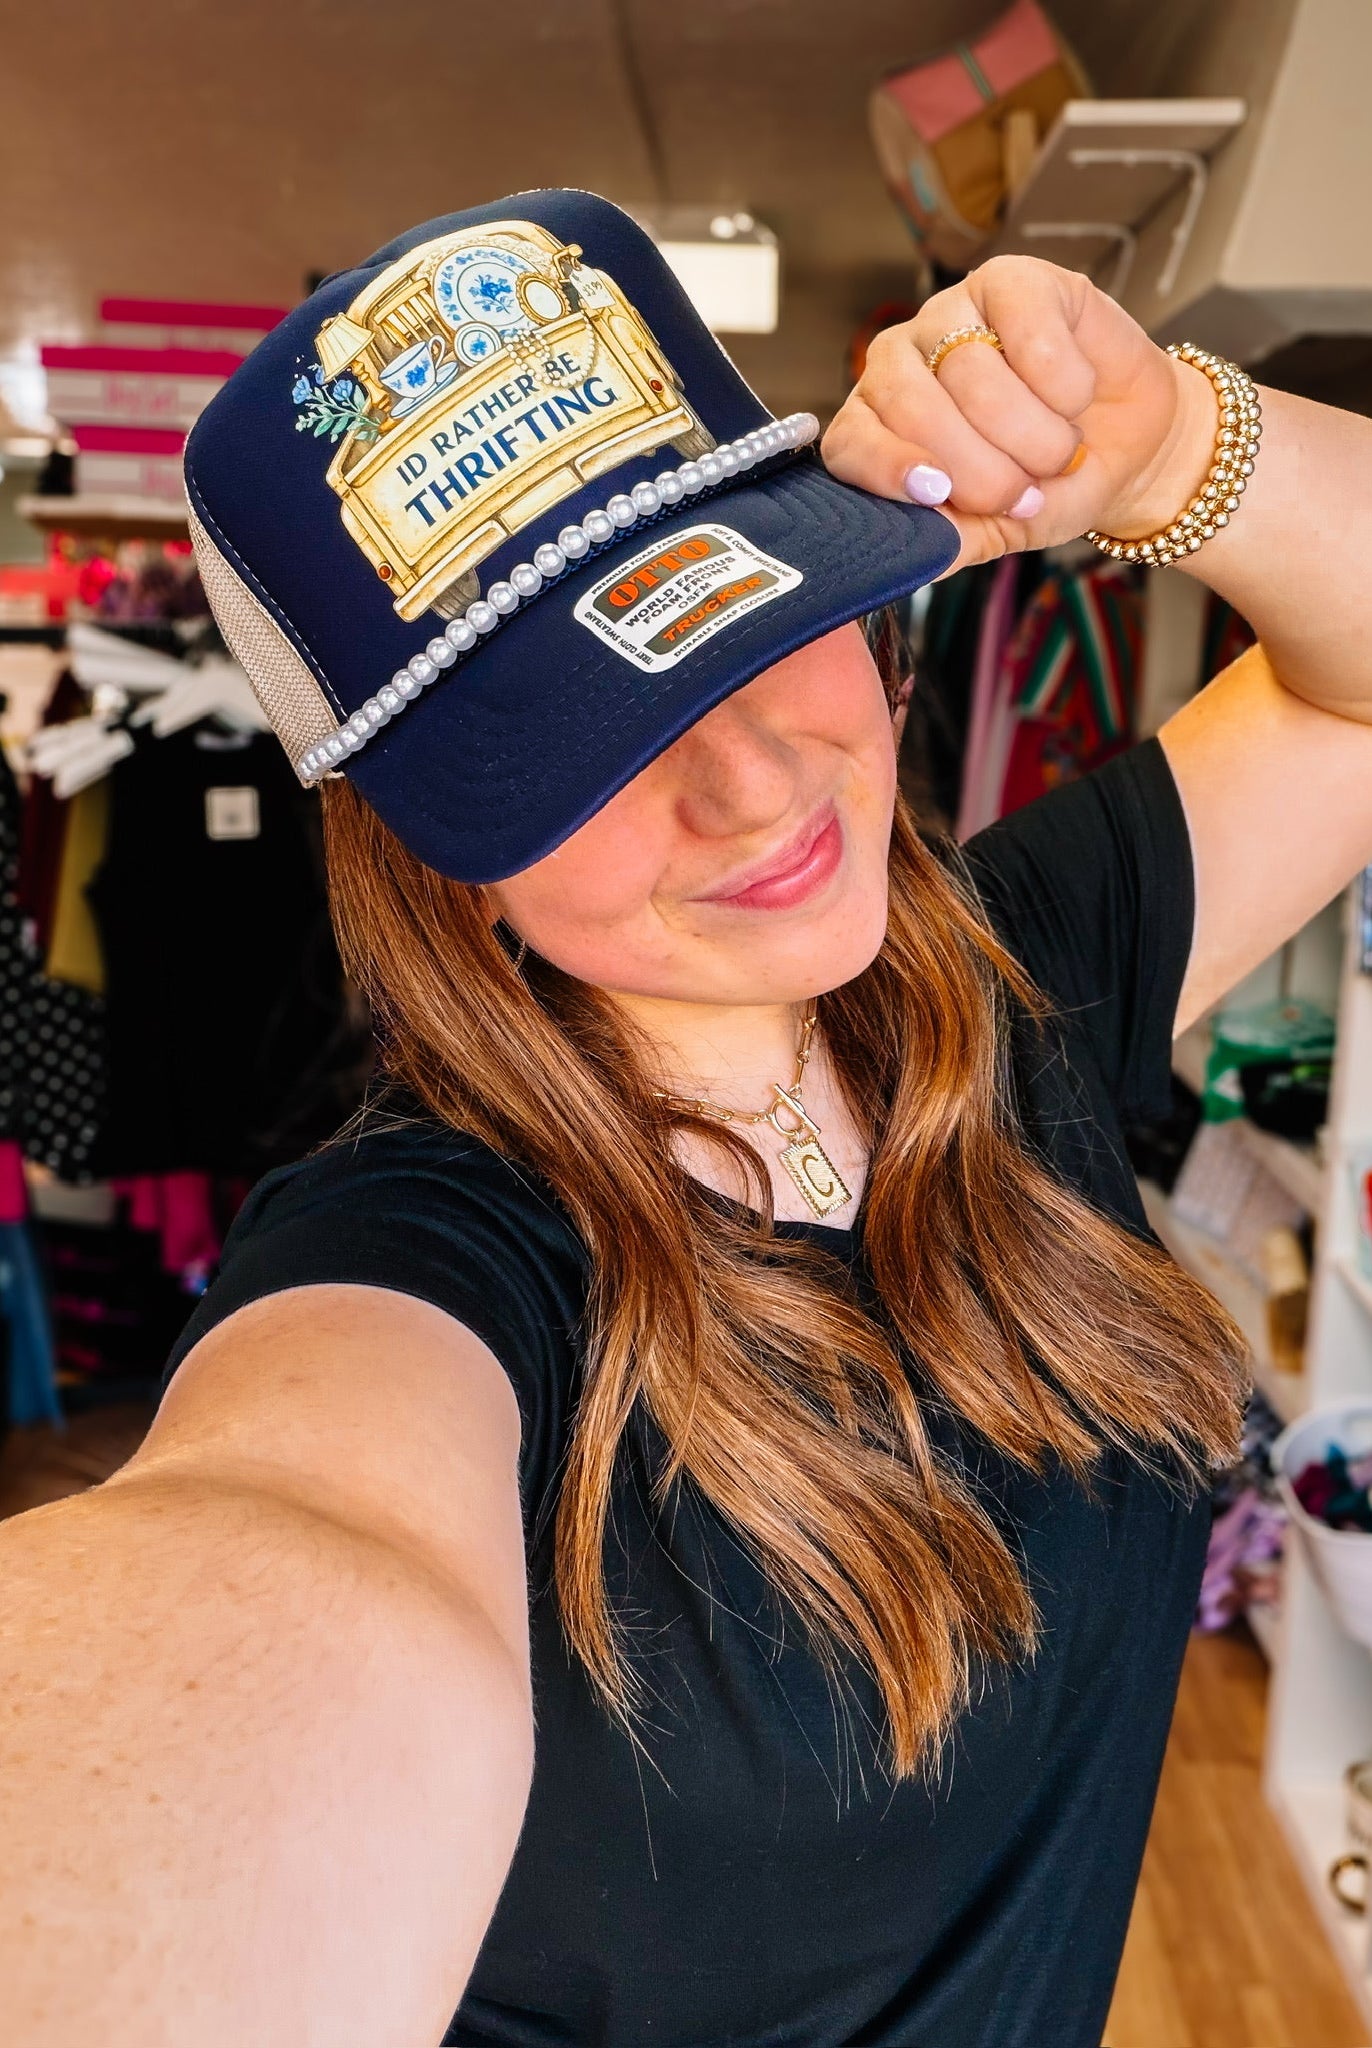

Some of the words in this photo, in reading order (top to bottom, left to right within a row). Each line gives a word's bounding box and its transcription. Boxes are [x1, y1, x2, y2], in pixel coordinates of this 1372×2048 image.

[429, 374, 541, 458] RATHER
[541, 351, 582, 382] BE
[404, 376, 618, 528] THRIFTING
[591, 565, 630, 595] PREMIUM
[630, 549, 657, 566] FOAM
[656, 533, 688, 550] FABRIC
[608, 538, 711, 607] OTTO
[624, 588, 674, 628] WORLD
[675, 555, 737, 588] FAMOUS
[643, 593, 683, 625] FOAM
[682, 566, 732, 597] FRONT
[677, 582, 713, 609] OSFM
[584, 611, 620, 641] SWEATBAND
[662, 576, 764, 643] TRUCKER
[673, 627, 714, 658] DURABLE
[713, 609, 739, 627] SNAP
[740, 588, 780, 610] CLOSURE
[618, 638, 638, 654] CLOTH
[635, 651, 654, 665] TERRY
